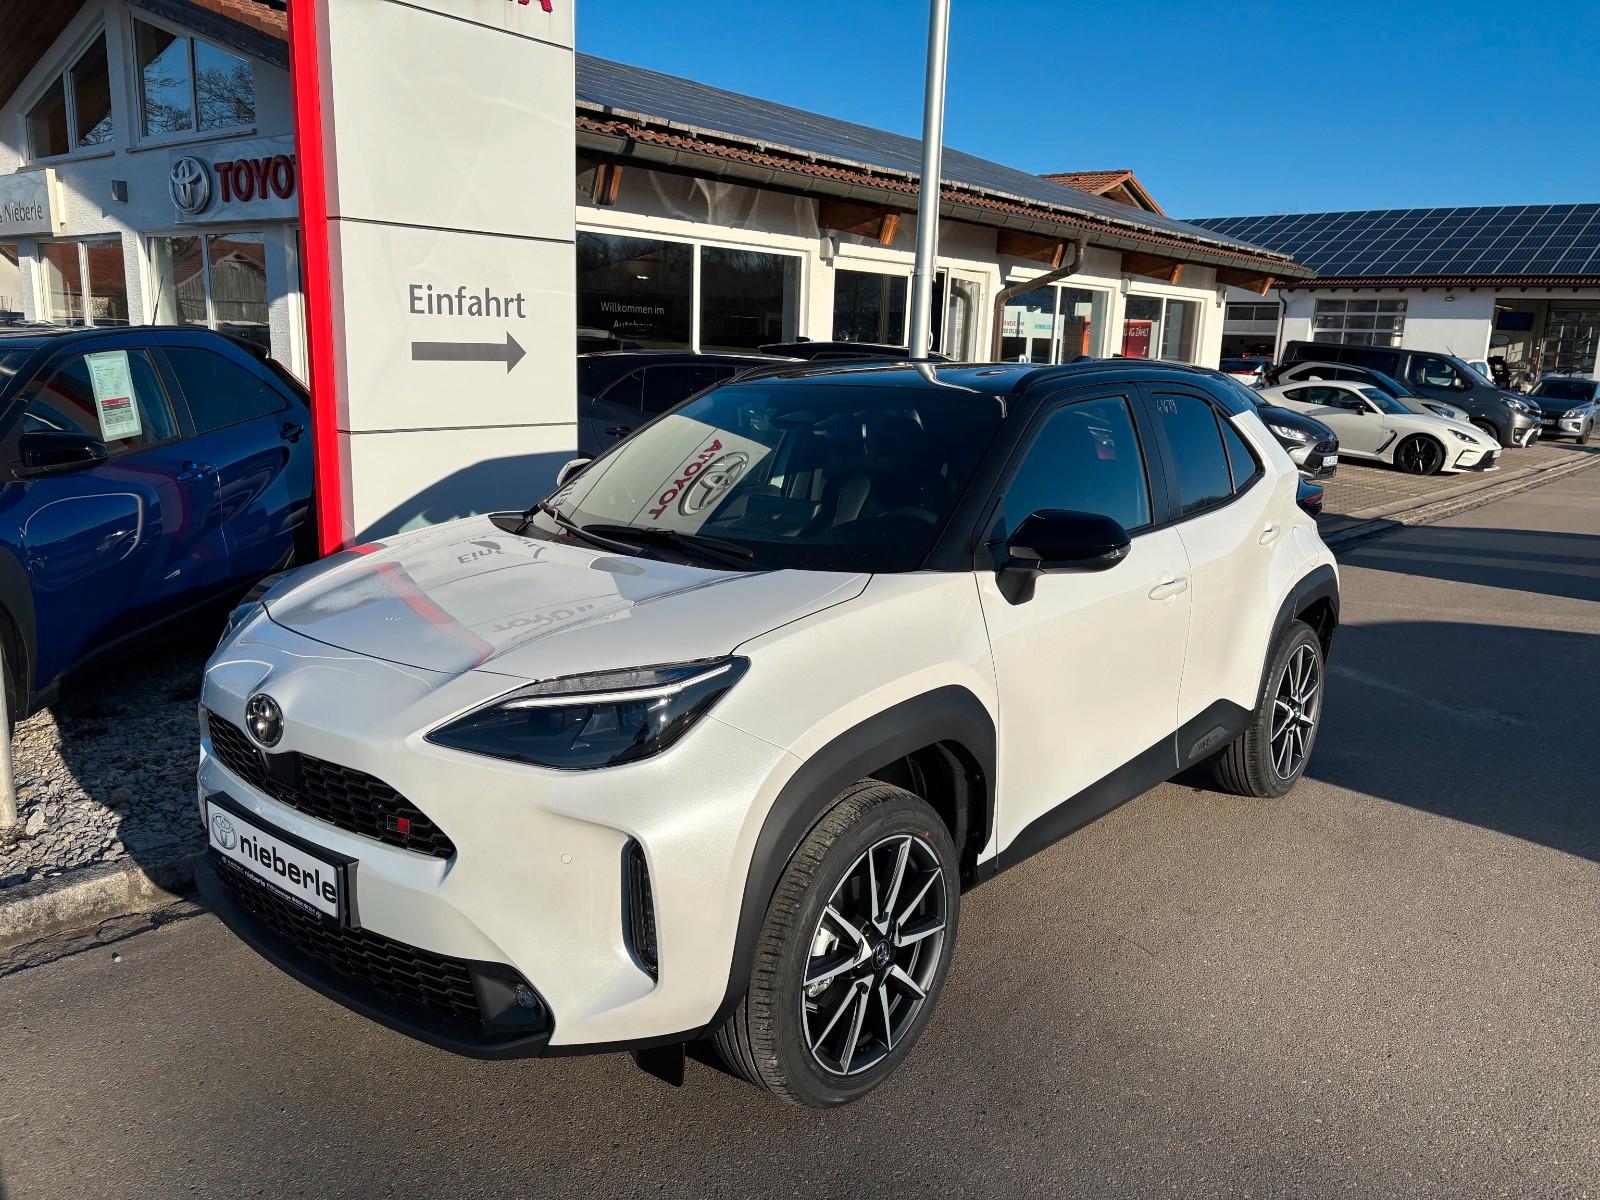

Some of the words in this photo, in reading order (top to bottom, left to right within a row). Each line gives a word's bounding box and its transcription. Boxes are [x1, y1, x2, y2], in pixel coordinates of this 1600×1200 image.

[214, 154, 296, 203] TOYO
[5, 200, 43, 223] Nieberle
[409, 284, 526, 318] Einfahrt
[600, 301, 653, 314] Willkommen
[654, 305, 665, 315] im
[240, 834, 337, 904] nieberle
